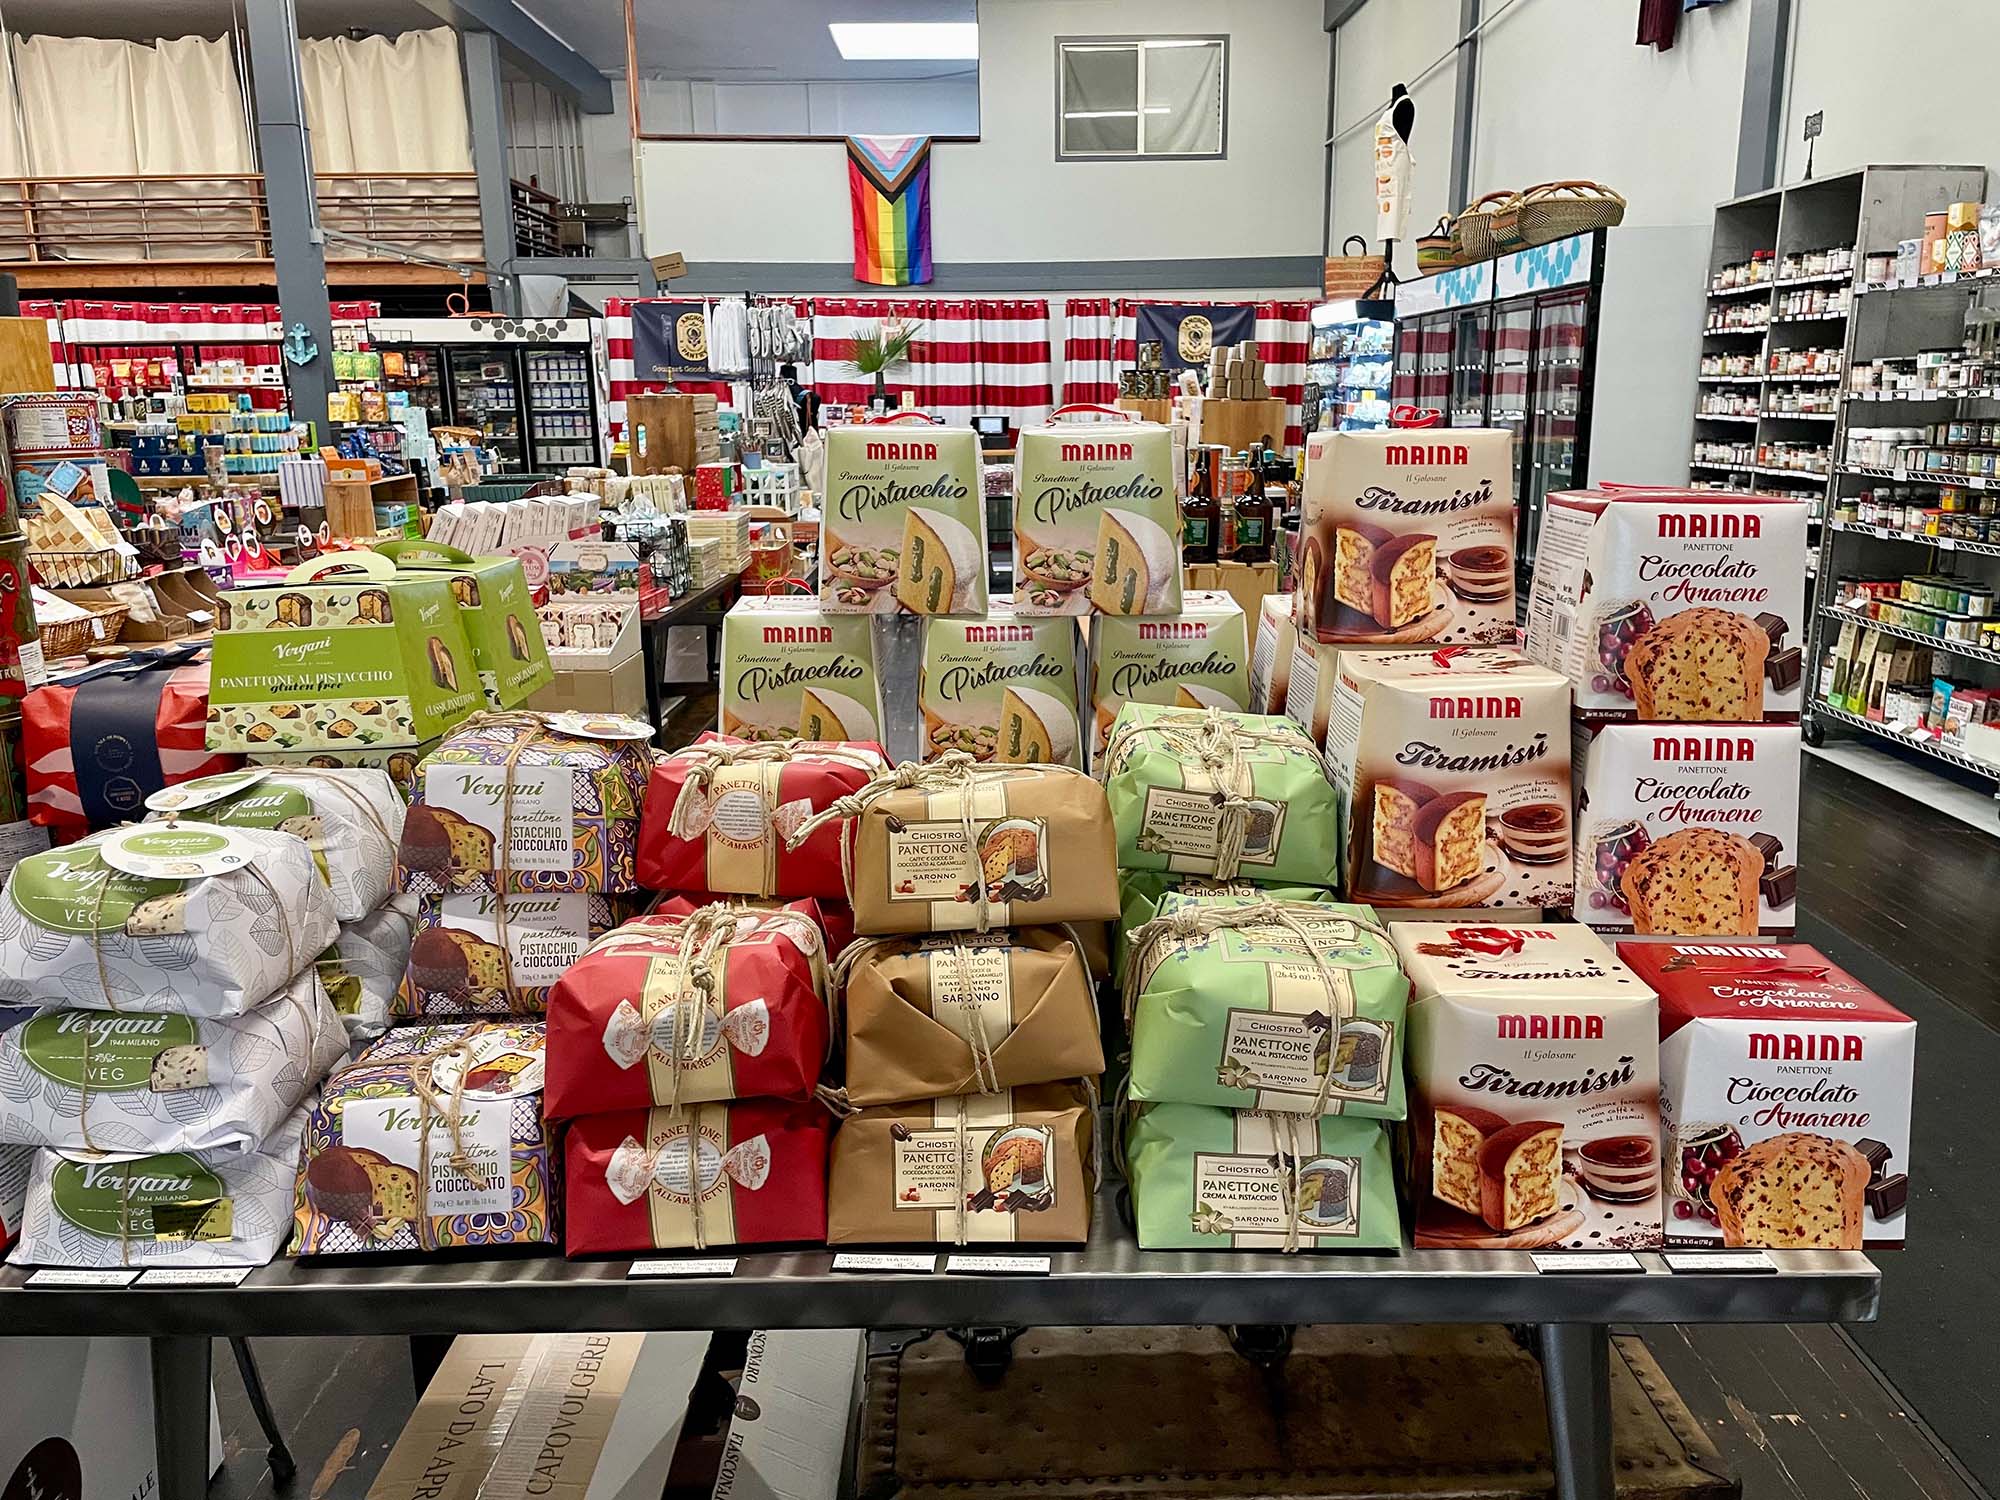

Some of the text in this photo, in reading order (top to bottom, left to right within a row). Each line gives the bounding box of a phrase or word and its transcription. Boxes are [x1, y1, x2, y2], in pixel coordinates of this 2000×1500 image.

[866, 443, 937, 461] MAINA
[1061, 443, 1133, 462] MAINA
[1385, 444, 1469, 466] MAINA
[838, 471, 885, 481] Panettone
[1033, 473, 1080, 483] Panettone
[839, 473, 969, 523] Pistacchio
[1034, 473, 1164, 525] Pistacchio
[1657, 514, 1761, 538] MAINA
[1683, 543, 1734, 552] PANETTONE
[1639, 554, 1759, 581] Cioccolato
[1650, 578, 1769, 603] e Amarene
[763, 626, 833, 643] MAINA
[965, 626, 1034, 643] MAINA
[1139, 623, 1208, 640] MAINA
[272, 636, 332, 662] Vergani
[736, 654, 781, 663] Panettone
[219, 675, 294, 689] PANETTONE
[316, 669, 393, 685] PISTACCHIO
[737, 655, 864, 703] Pistacchio
[940, 652, 1064, 702] Pistacchio
[1112, 650, 1237, 699] Pistacchio
[270, 680, 344, 695] gluten free
[1429, 697, 1521, 719] MAINA
[1652, 737, 1755, 761] MAINA
[1678, 766, 1728, 775] PANETTONE
[1634, 777, 1753, 803] Cioccolato
[1166, 798, 1210, 810] CHIOSTRO
[1646, 800, 1763, 823] e Amarene
[252, 810, 281, 818] MILANO
[1150, 810, 1216, 825] PANETTONE
[911, 832, 962, 840] CHIOSTRO
[898, 843, 968, 856] PANETTONE
[1173, 840, 1212, 849] SARONNO
[912, 873, 957, 881] SARONNO
[111, 885, 148, 894] MILANO
[64, 908, 101, 923] VEG
[519, 925, 578, 944] panettone
[520, 941, 578, 956] PISTACCHIO
[1671, 944, 1789, 960] MAINA
[523, 955, 580, 968] CIOCCOLAT
[1734, 978, 1802, 988] PANETTONE
[1709, 984, 1833, 1000] Cioccolato
[1739, 996, 1859, 1010] e Amarene
[1250, 1022, 1303, 1034] CHIOSTRO
[1496, 1015, 1604, 1040] MAINA
[109, 1038, 160, 1047] 1944 MILANO
[1233, 1036, 1312, 1053] PANETTONE
[1748, 1033, 1864, 1062] MAINA
[1231, 1047, 1308, 1062] CREMA AL PISTACCHIO
[1523, 1050, 1577, 1062] Il Golosone
[87, 1068, 125, 1081] VEG
[1262, 1072, 1308, 1083] SARONNO
[1776, 1065, 1833, 1075] PANETTONE
[1726, 1077, 1861, 1105] Cioccolato
[1739, 1102, 1872, 1129] e Amarene
[652, 1124, 722, 1146] PANETONE
[1217, 1165, 1269, 1175] CHIOSTRO
[1202, 1180, 1280, 1193] PANETTONE
[1202, 1192, 1226, 1200] CREMA
[1238, 1193, 1278, 1202] PISTACCHIO
[458, 1362, 506, 1415] LATO
[525, 1335, 612, 1496] CAPOVOLGERE
[439, 1420, 477, 1452] DA
